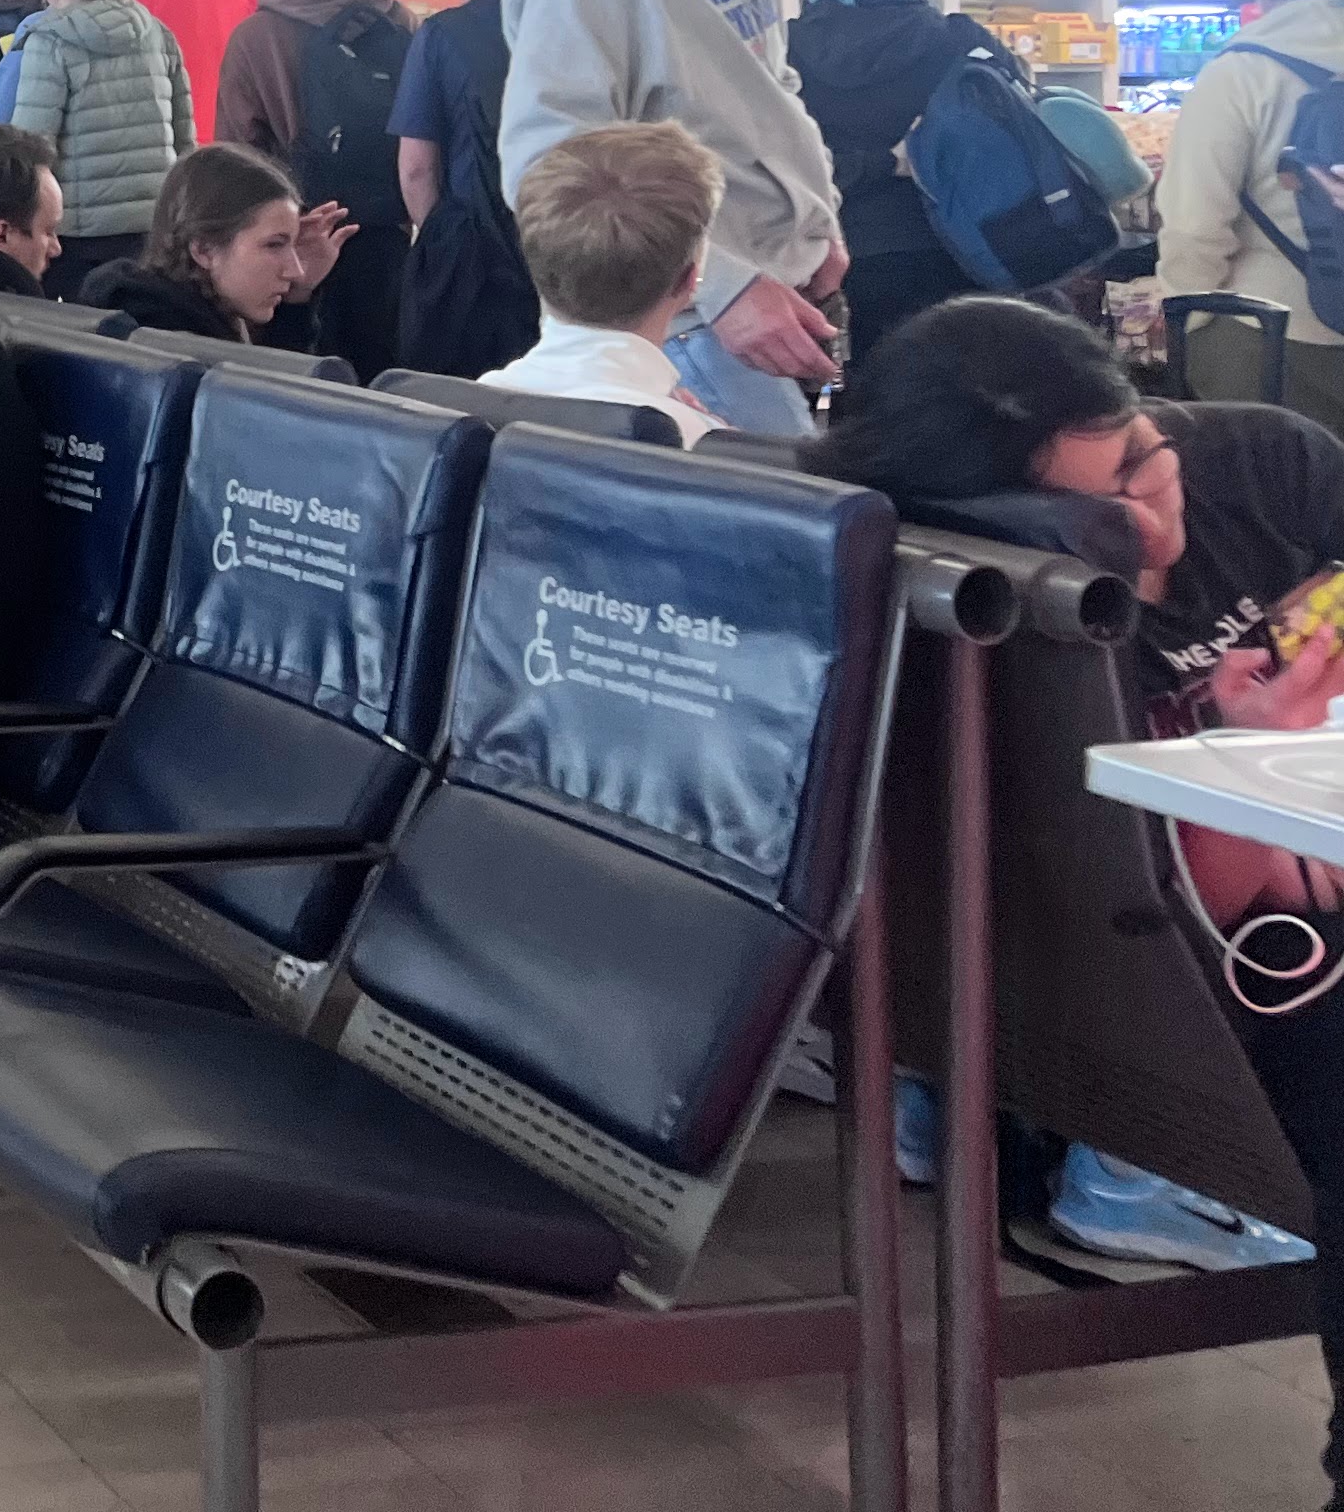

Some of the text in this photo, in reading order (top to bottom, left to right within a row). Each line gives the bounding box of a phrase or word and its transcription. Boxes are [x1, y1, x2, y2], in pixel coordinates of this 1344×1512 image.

[226, 478, 361, 533] Courtesy Seats
[539, 576, 739, 648] Courtesy Seats
